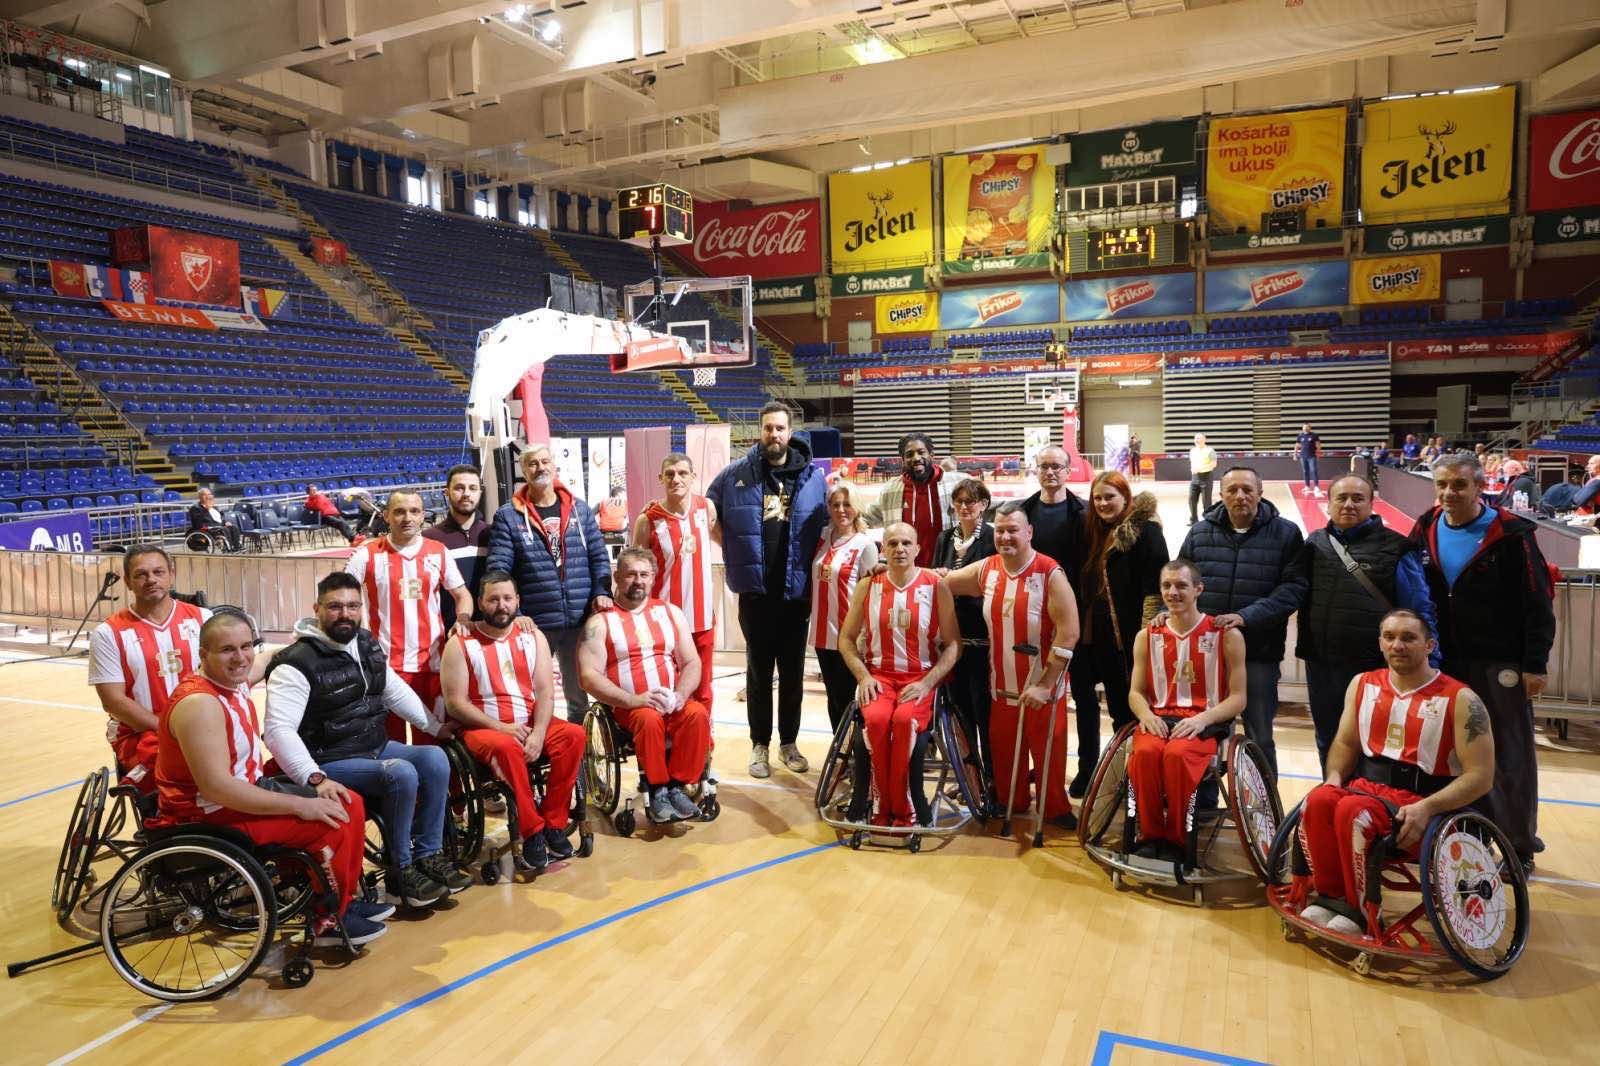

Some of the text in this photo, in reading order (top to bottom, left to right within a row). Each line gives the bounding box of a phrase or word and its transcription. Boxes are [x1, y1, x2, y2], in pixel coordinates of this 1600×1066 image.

[1218, 123, 1290, 142] Košarka
[1219, 141, 1287, 158] ima bolji
[1230, 158, 1275, 173] ukus
[1380, 148, 1487, 199] Jelen
[644, 206, 656, 229] 7
[694, 208, 813, 262] Coca-Cola
[844, 210, 916, 252] Jelen
[399, 578, 422, 600] 12
[888, 607, 911, 630] 10
[1003, 598, 1015, 618] 7
[156, 648, 184, 677] 15
[1173, 660, 1195, 683] 14
[1387, 723, 1405, 750] 9
